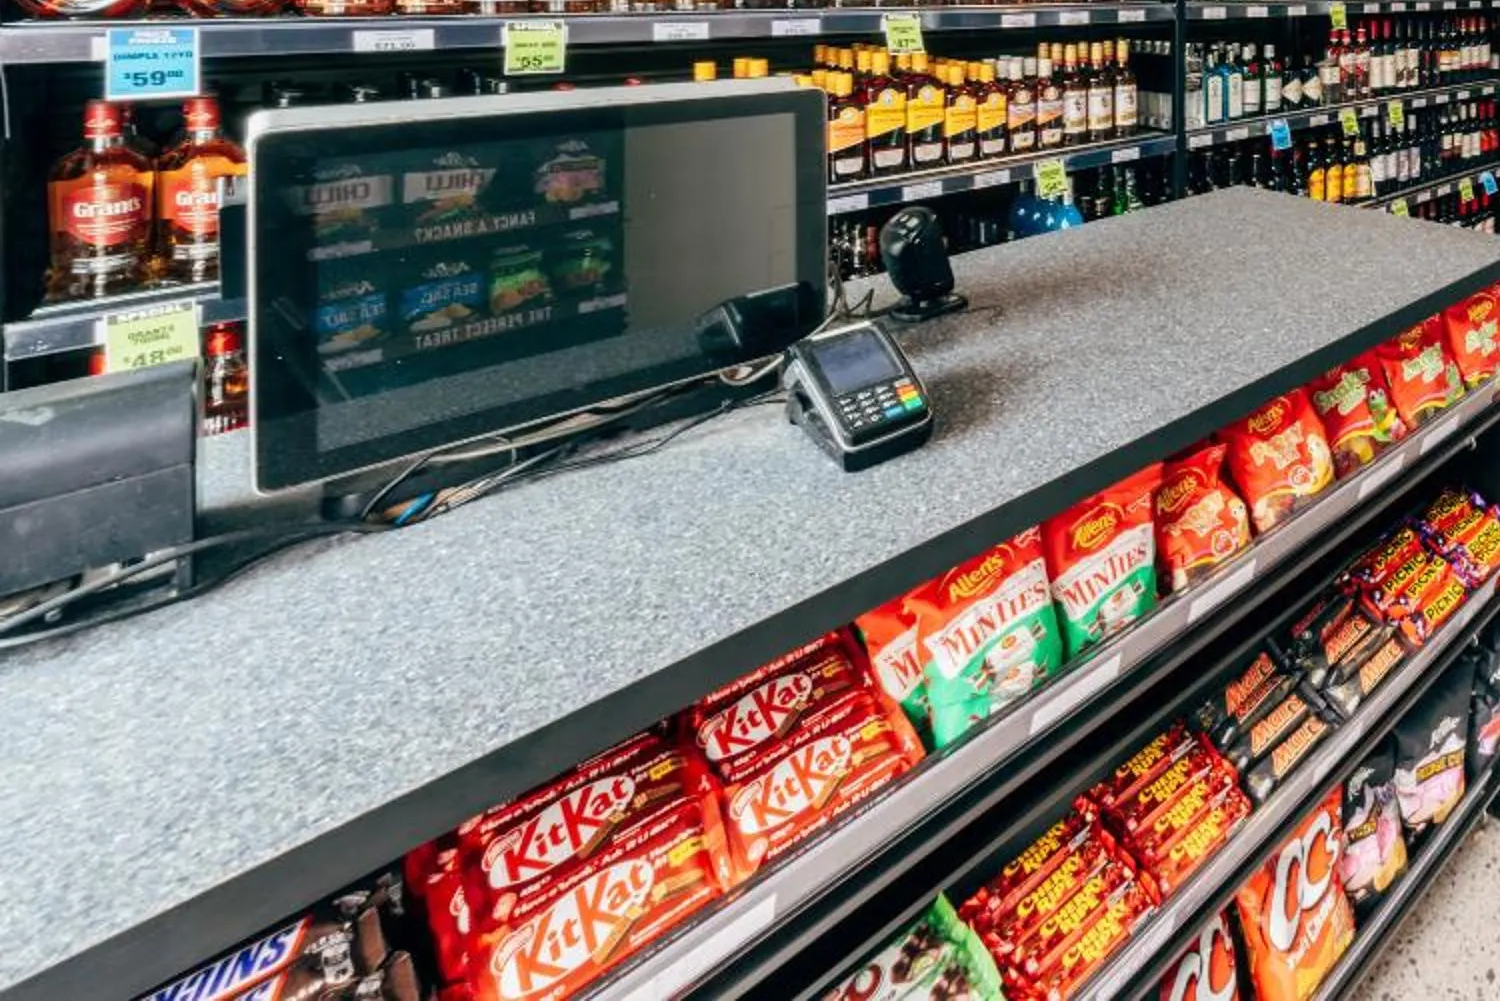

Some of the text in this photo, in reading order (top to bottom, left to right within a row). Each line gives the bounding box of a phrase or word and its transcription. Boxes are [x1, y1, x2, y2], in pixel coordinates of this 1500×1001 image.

[1384, 552, 1426, 592] PICNIC
[1426, 582, 1463, 620] PICNIC
[940, 581, 1048, 667] MINTIES
[713, 675, 808, 756] KitKat
[750, 739, 845, 828] KitKat
[503, 777, 628, 882] KitKat
[515, 862, 645, 992] KitKat
